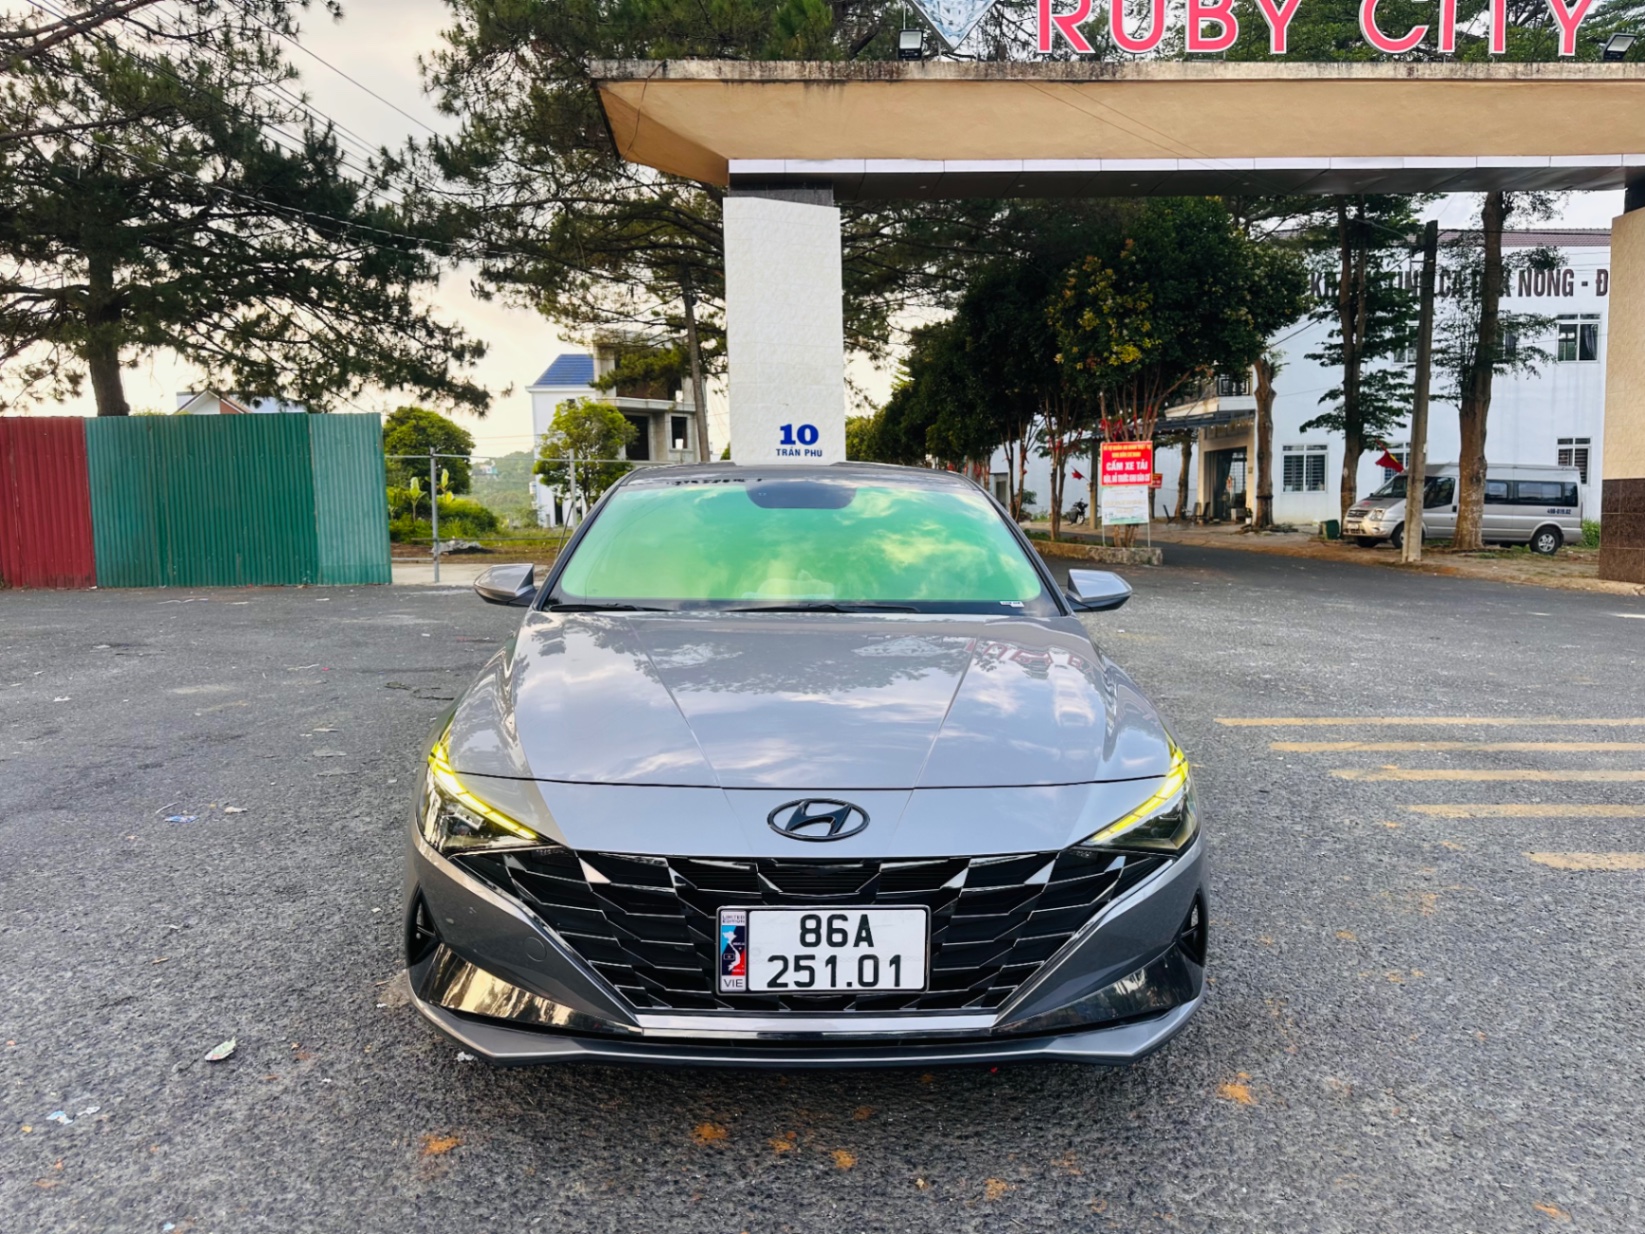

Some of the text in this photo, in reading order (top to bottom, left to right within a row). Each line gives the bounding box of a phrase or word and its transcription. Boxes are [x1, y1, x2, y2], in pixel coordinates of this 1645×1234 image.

[1037, 0, 1302, 54] RUBY
[780, 423, 819, 445] 10
[1125, 461, 1135, 470] XE
[799, 914, 874, 947] 86A
[723, 979, 743, 987] VIE
[766, 954, 901, 988] 251.01
